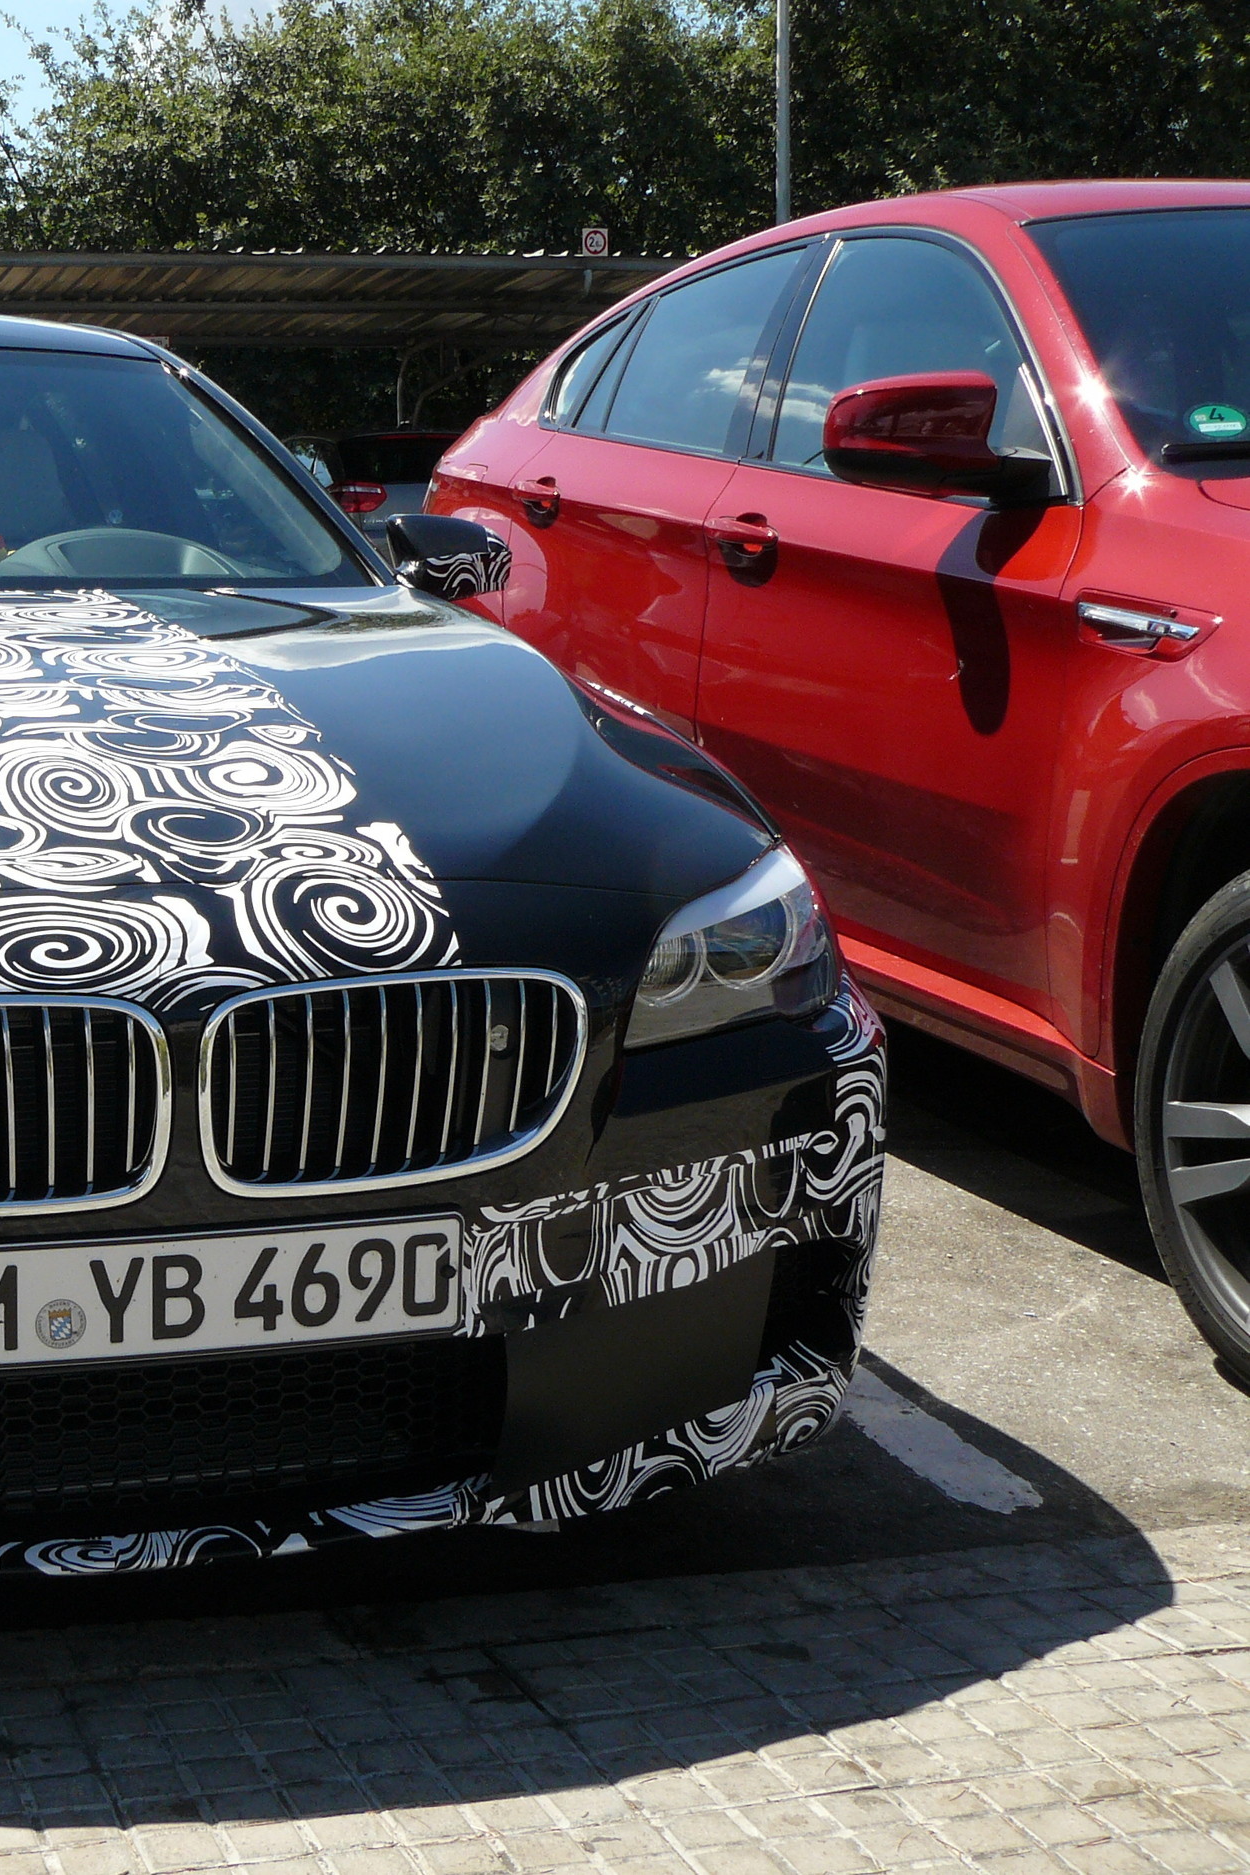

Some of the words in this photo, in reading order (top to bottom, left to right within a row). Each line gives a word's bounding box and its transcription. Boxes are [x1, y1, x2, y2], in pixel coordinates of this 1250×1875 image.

[1209, 408, 1224, 421] 4
[89, 1253, 206, 1343] YB
[234, 1232, 451, 1332] 4690
